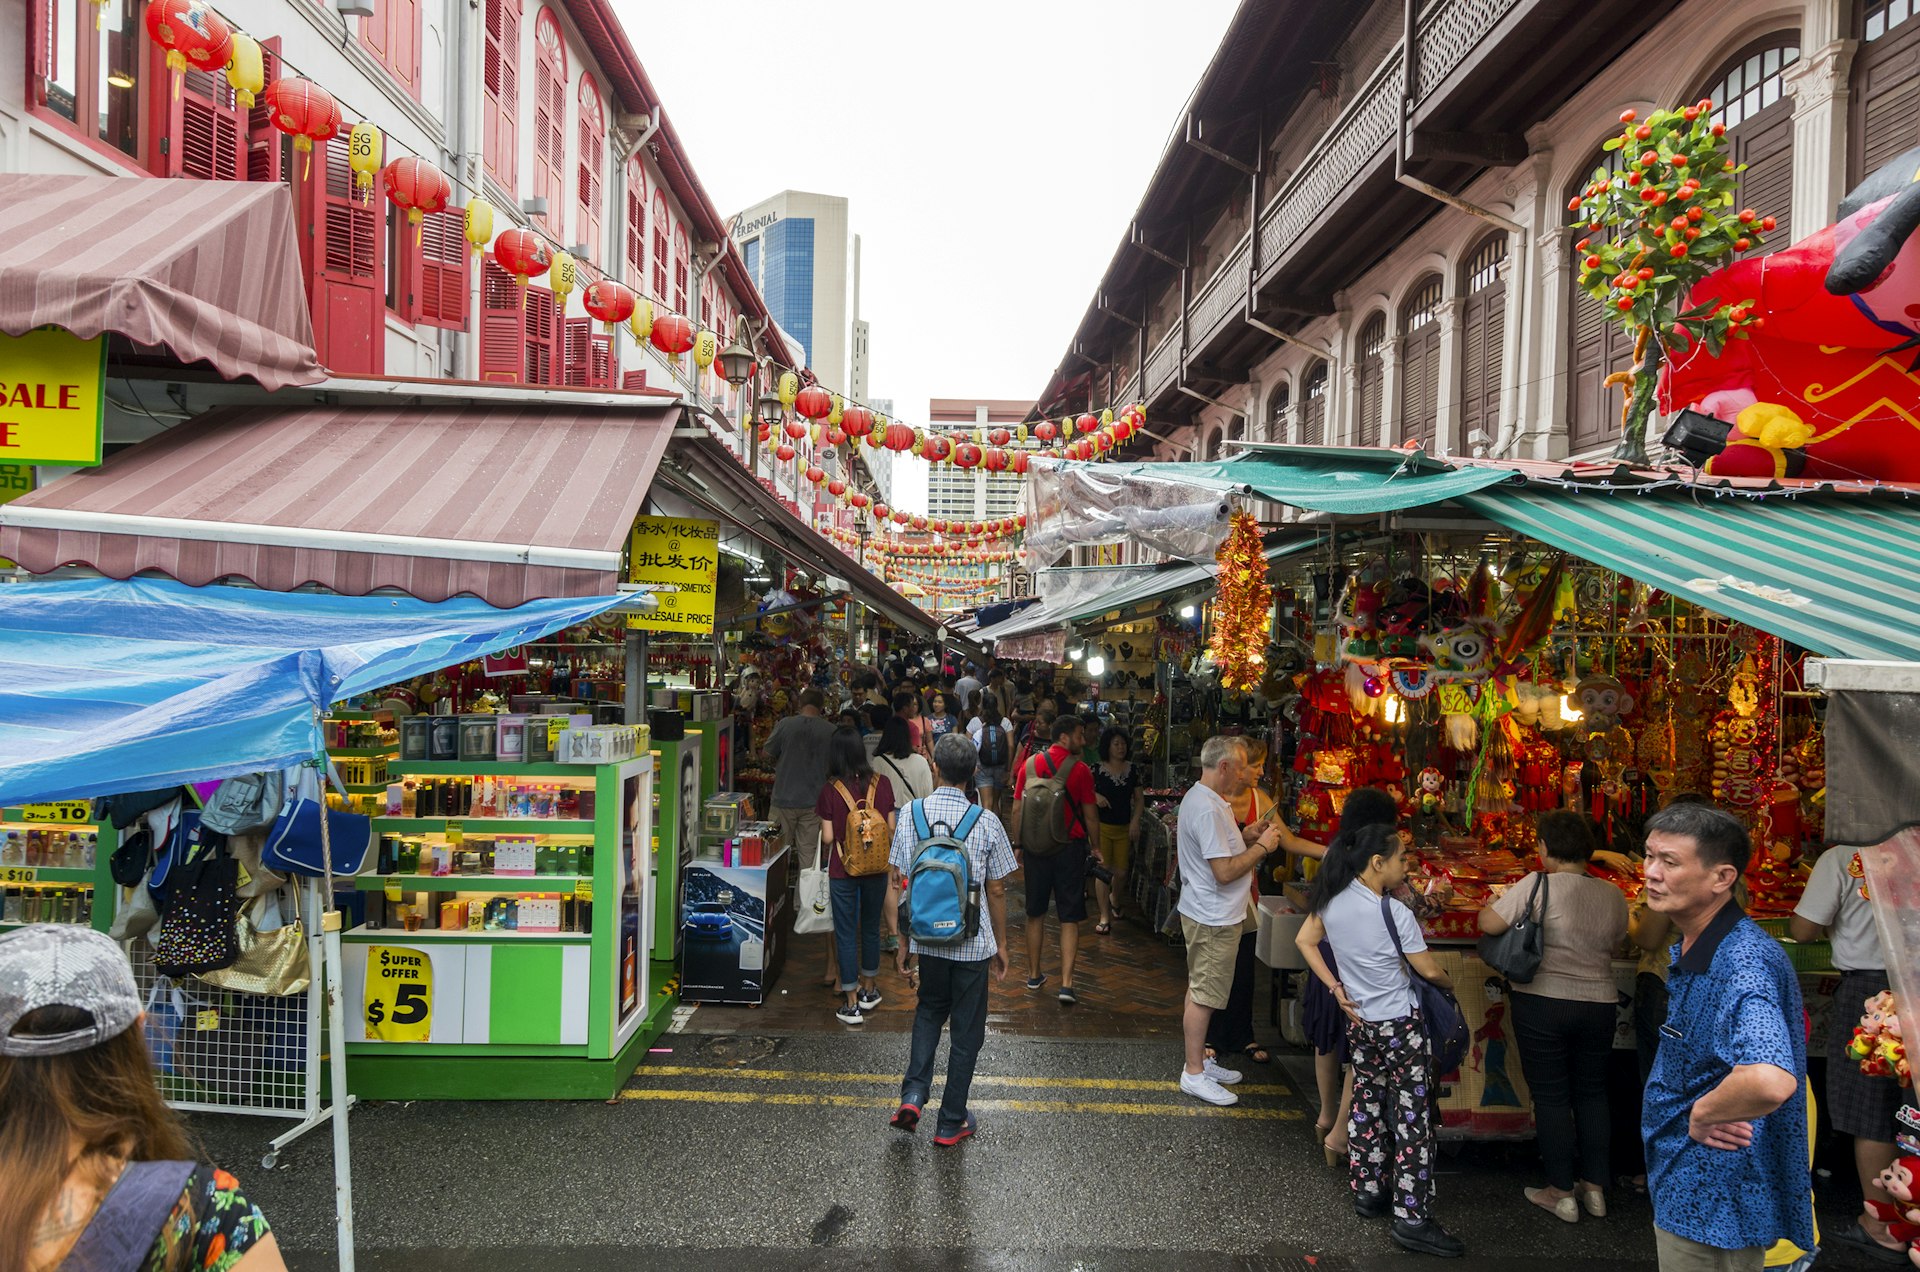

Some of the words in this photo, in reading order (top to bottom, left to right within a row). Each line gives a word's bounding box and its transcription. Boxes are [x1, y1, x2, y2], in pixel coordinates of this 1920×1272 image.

[353, 132, 371, 144] SG
[352, 144, 371, 156] 50
[726, 212, 777, 238] PERENNIAL
[562, 263, 575, 273] SG
[561, 273, 575, 283] 50
[702, 339, 714, 349] SG
[702, 348, 714, 357] 50
[634, 521, 718, 540] 香水/化妆品
[639, 551, 713, 572] 批发价
[687, 613, 712, 625] PRICE
[7, 869, 33, 881] $10
[381, 968, 419, 979] OFFER
